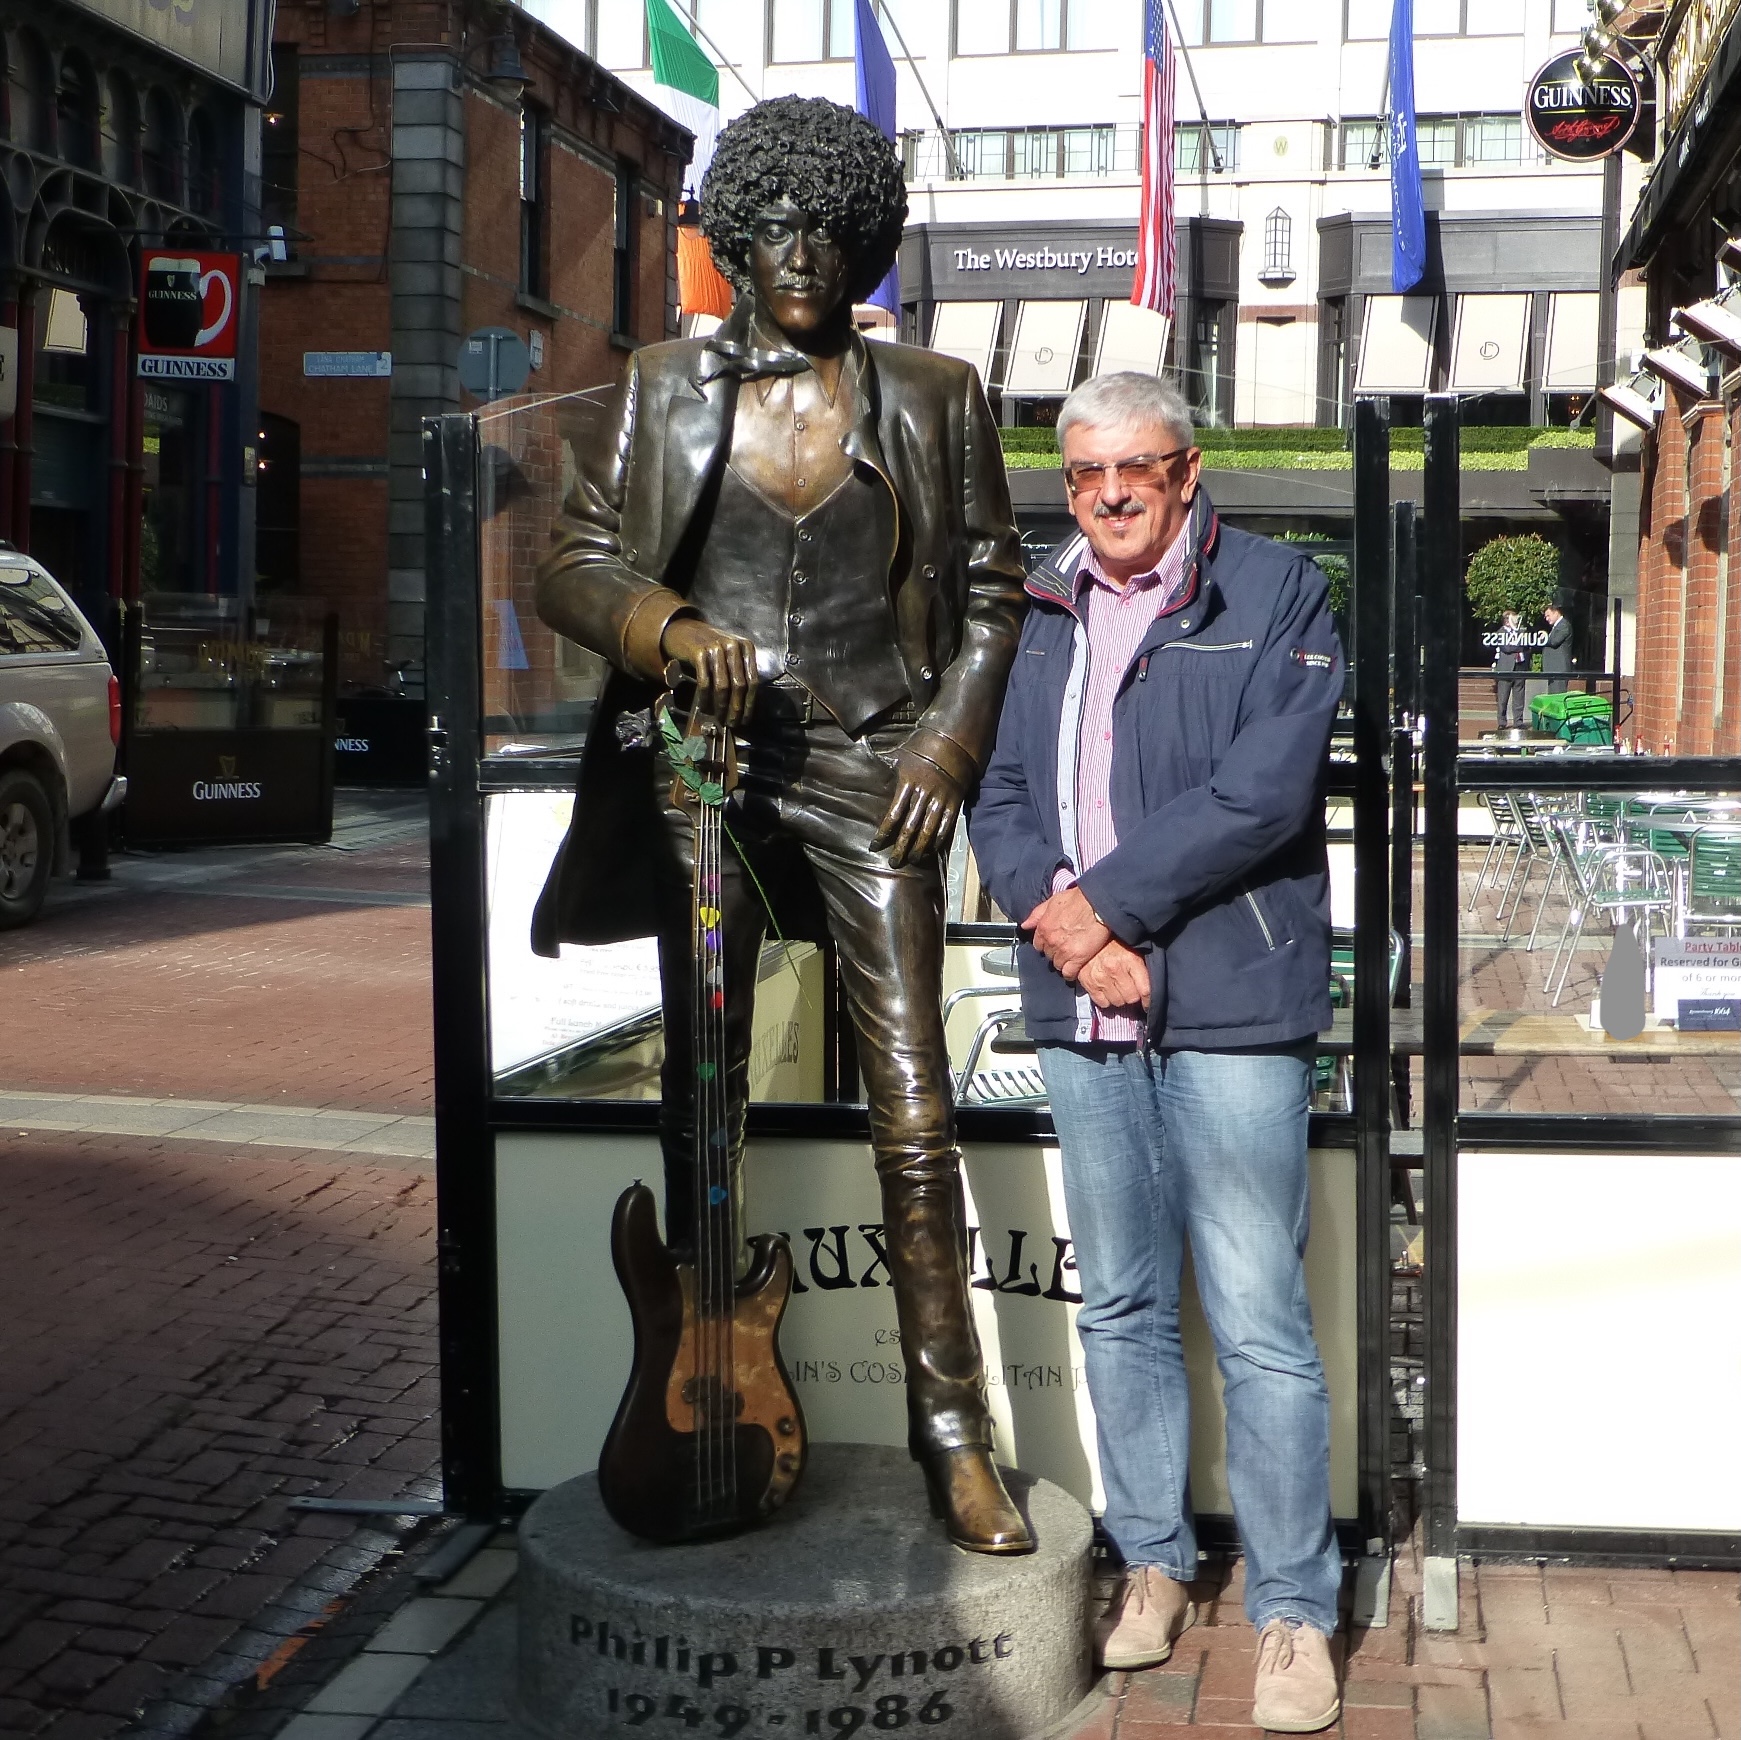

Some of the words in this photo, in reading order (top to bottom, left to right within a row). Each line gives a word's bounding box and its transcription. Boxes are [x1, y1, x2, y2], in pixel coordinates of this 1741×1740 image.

[1534, 86, 1632, 108] GUINNESS
[954, 248, 991, 270] The
[994, 246, 1092, 274] Westbury
[148, 290, 197, 300] GUINNESS
[141, 359, 229, 378] GUINNESS
[193, 781, 261, 800] GUINNESS
[1684, 941, 1713, 953] Party
[1660, 956, 1709, 967] Reserved
[1713, 956, 1728, 967] for
[1682, 972, 1693, 982] of
[1696, 973, 1702, 982] 6
[1705, 974, 1717, 982] or
[570, 1614, 738, 1688] Philip
[757, 1646, 796, 1679] P
[818, 1632, 1014, 1693] Lynott
[608, 1687, 751, 1738] 1949
[806, 1690, 955, 1740] 1986
